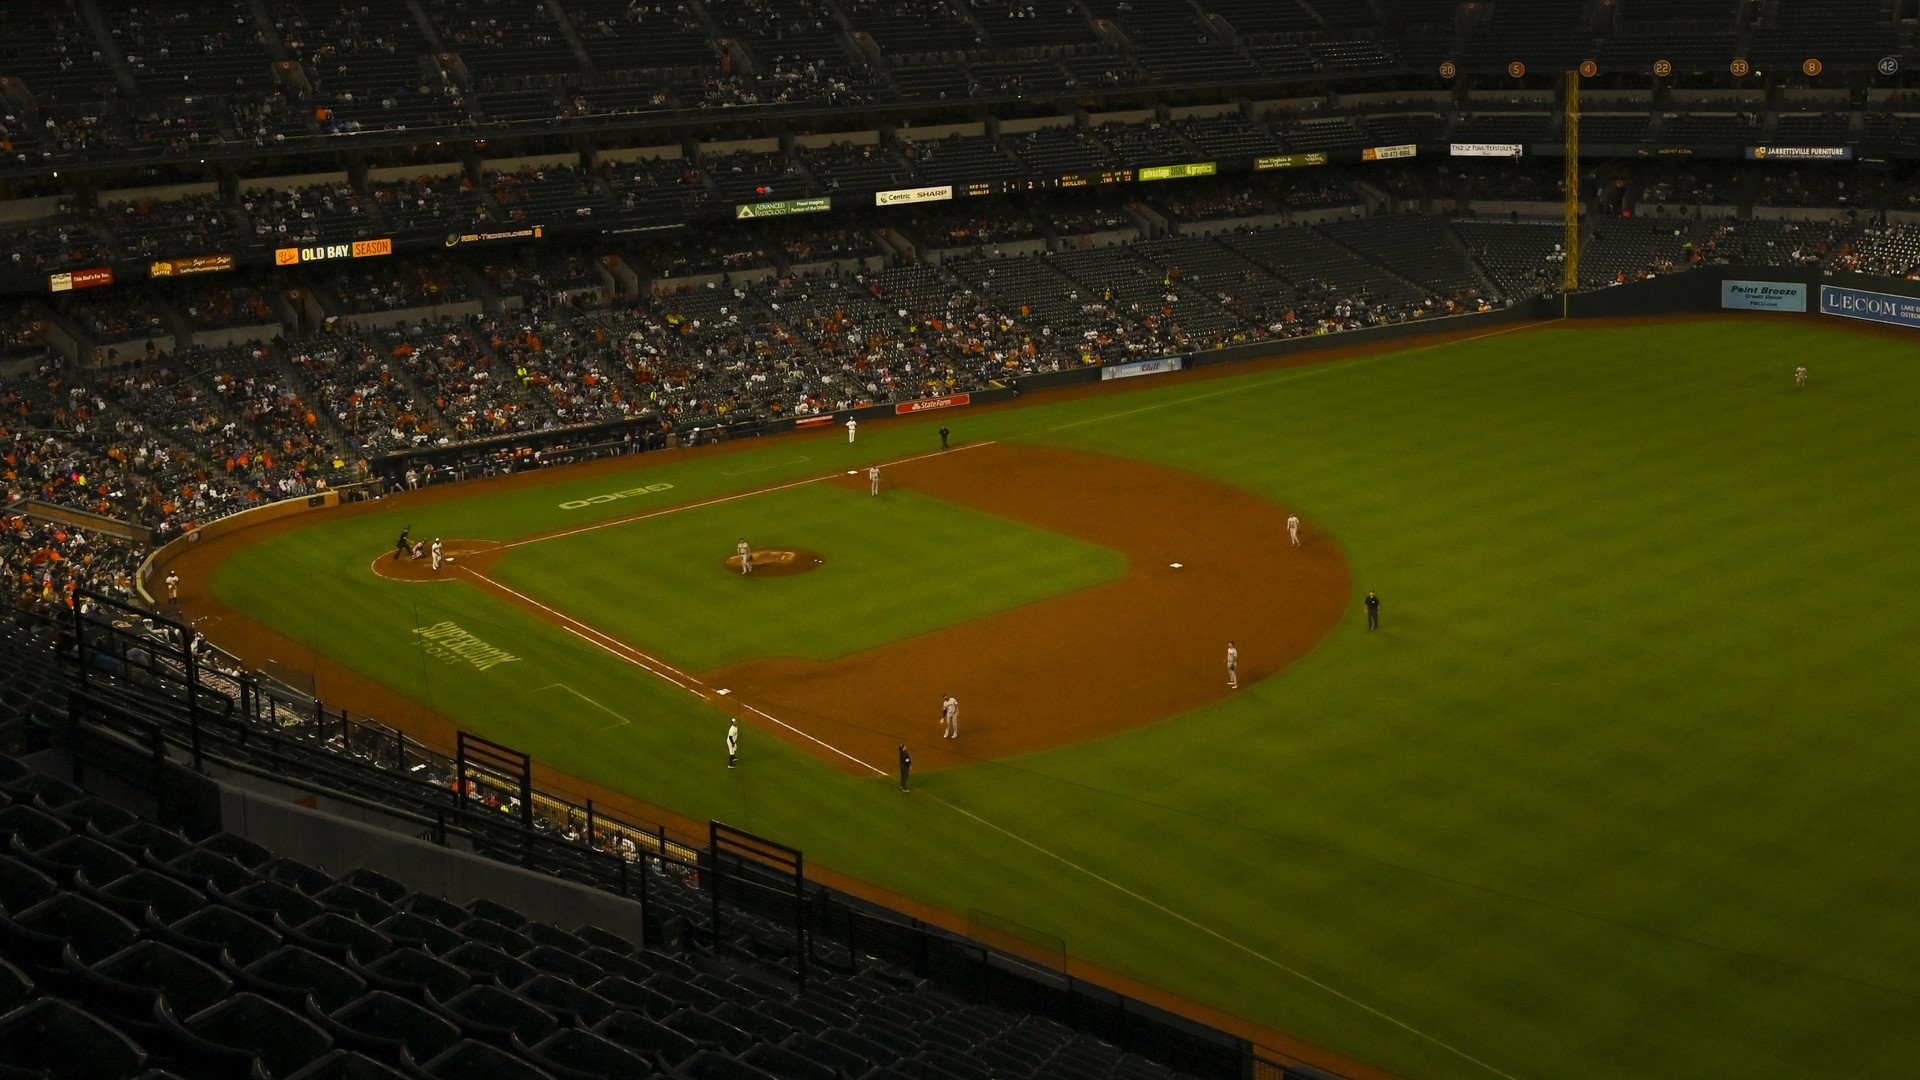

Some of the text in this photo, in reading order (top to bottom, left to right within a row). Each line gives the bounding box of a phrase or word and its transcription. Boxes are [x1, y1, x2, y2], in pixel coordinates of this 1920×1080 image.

[1442, 66, 1453, 75] 20
[1656, 63, 1669, 73] 22
[1733, 62, 1746, 73] 33
[1880, 61, 1895, 71] 42
[1144, 169, 1169, 179] advantage
[888, 190, 948, 200] Centric SHARP
[302, 247, 325, 261] OLD
[356, 240, 388, 256] SEASON
[1760, 286, 1797, 296] Breeze
[1141, 362, 1160, 372] Chill
[558, 482, 675, 510] GEICO
[412, 621, 522, 671] SUPERBOOK
